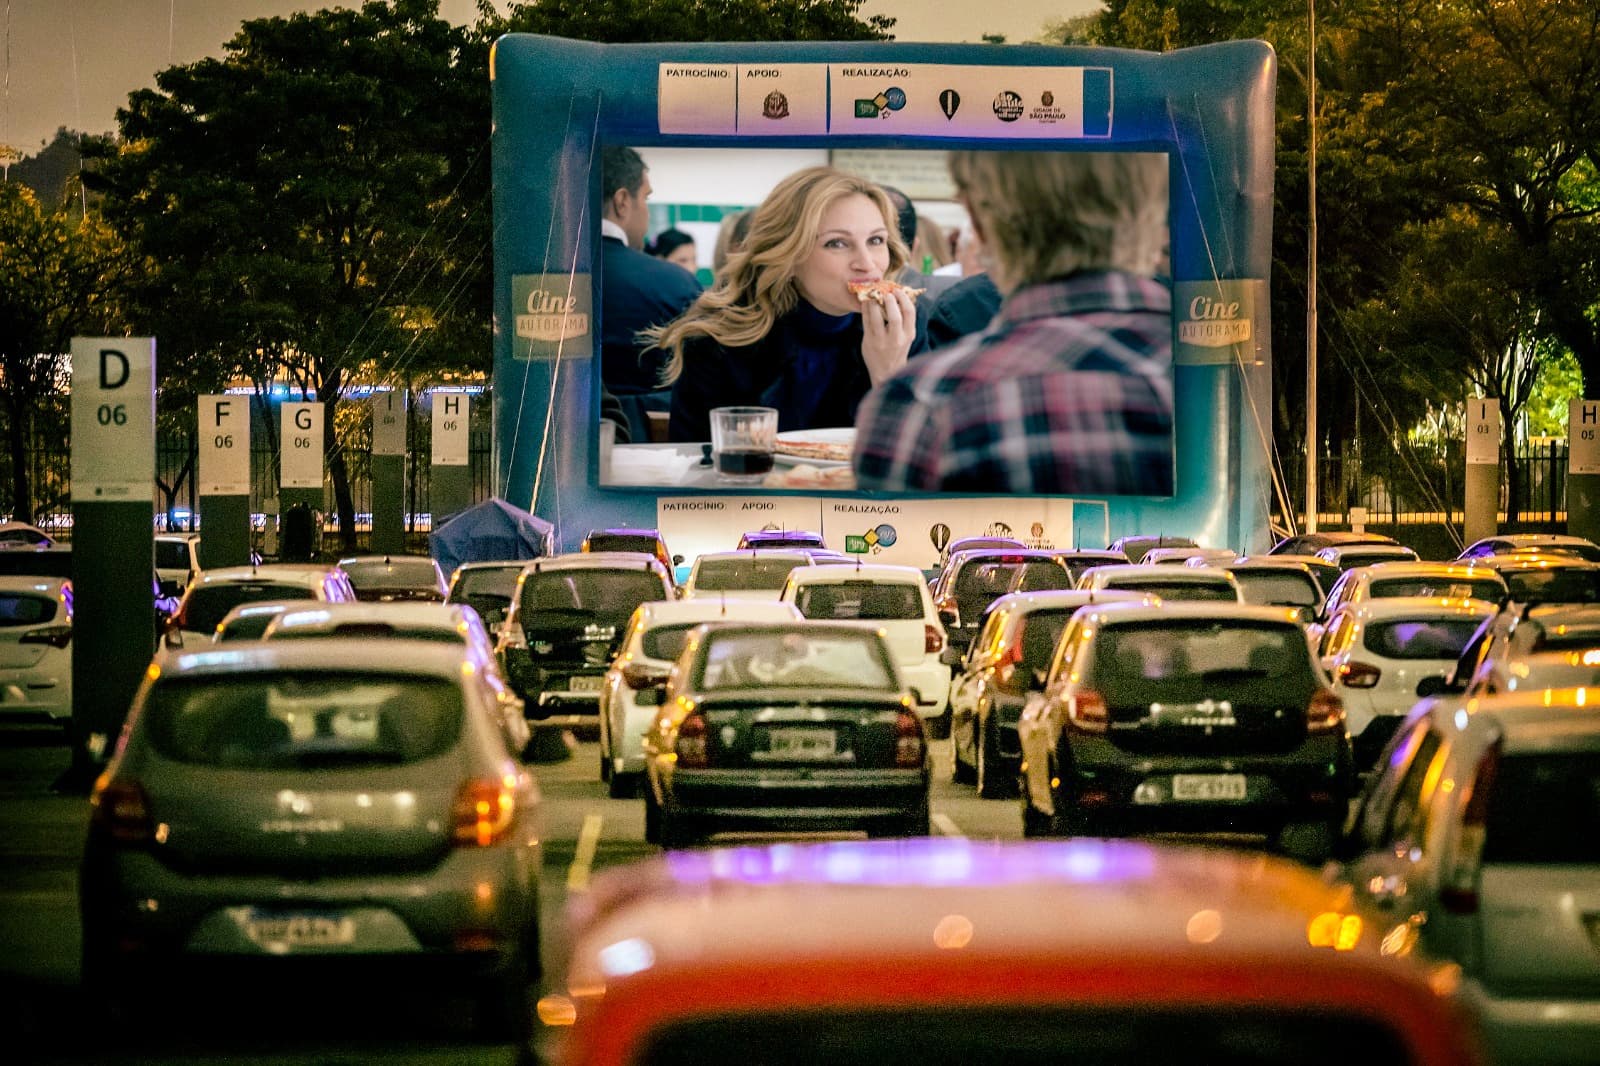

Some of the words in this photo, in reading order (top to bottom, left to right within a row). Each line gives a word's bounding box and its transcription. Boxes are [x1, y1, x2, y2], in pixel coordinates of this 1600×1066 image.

[666, 68, 731, 78] PATROCÍNIO:
[747, 69, 782, 78] APOIO:
[842, 67, 911, 78] REALIZAÇÃO:
[528, 290, 577, 313] Cine
[1190, 296, 1239, 320] Cine
[1182, 323, 1248, 337] AUTORAMA
[99, 349, 130, 390] D
[445, 396, 459, 415] H
[1482, 403, 1485, 420] I
[97, 403, 127, 426] 06
[215, 401, 231, 427] F
[294, 408, 312, 430] G
[1582, 405, 1597, 424] H
[443, 420, 457, 431] 06
[214, 434, 233, 448] 06
[1581, 429, 1595, 441] 05
[294, 436, 310, 449] 06
[663, 501, 727, 511] PATROCÍNIO:
[741, 502, 777, 511] APOIO:
